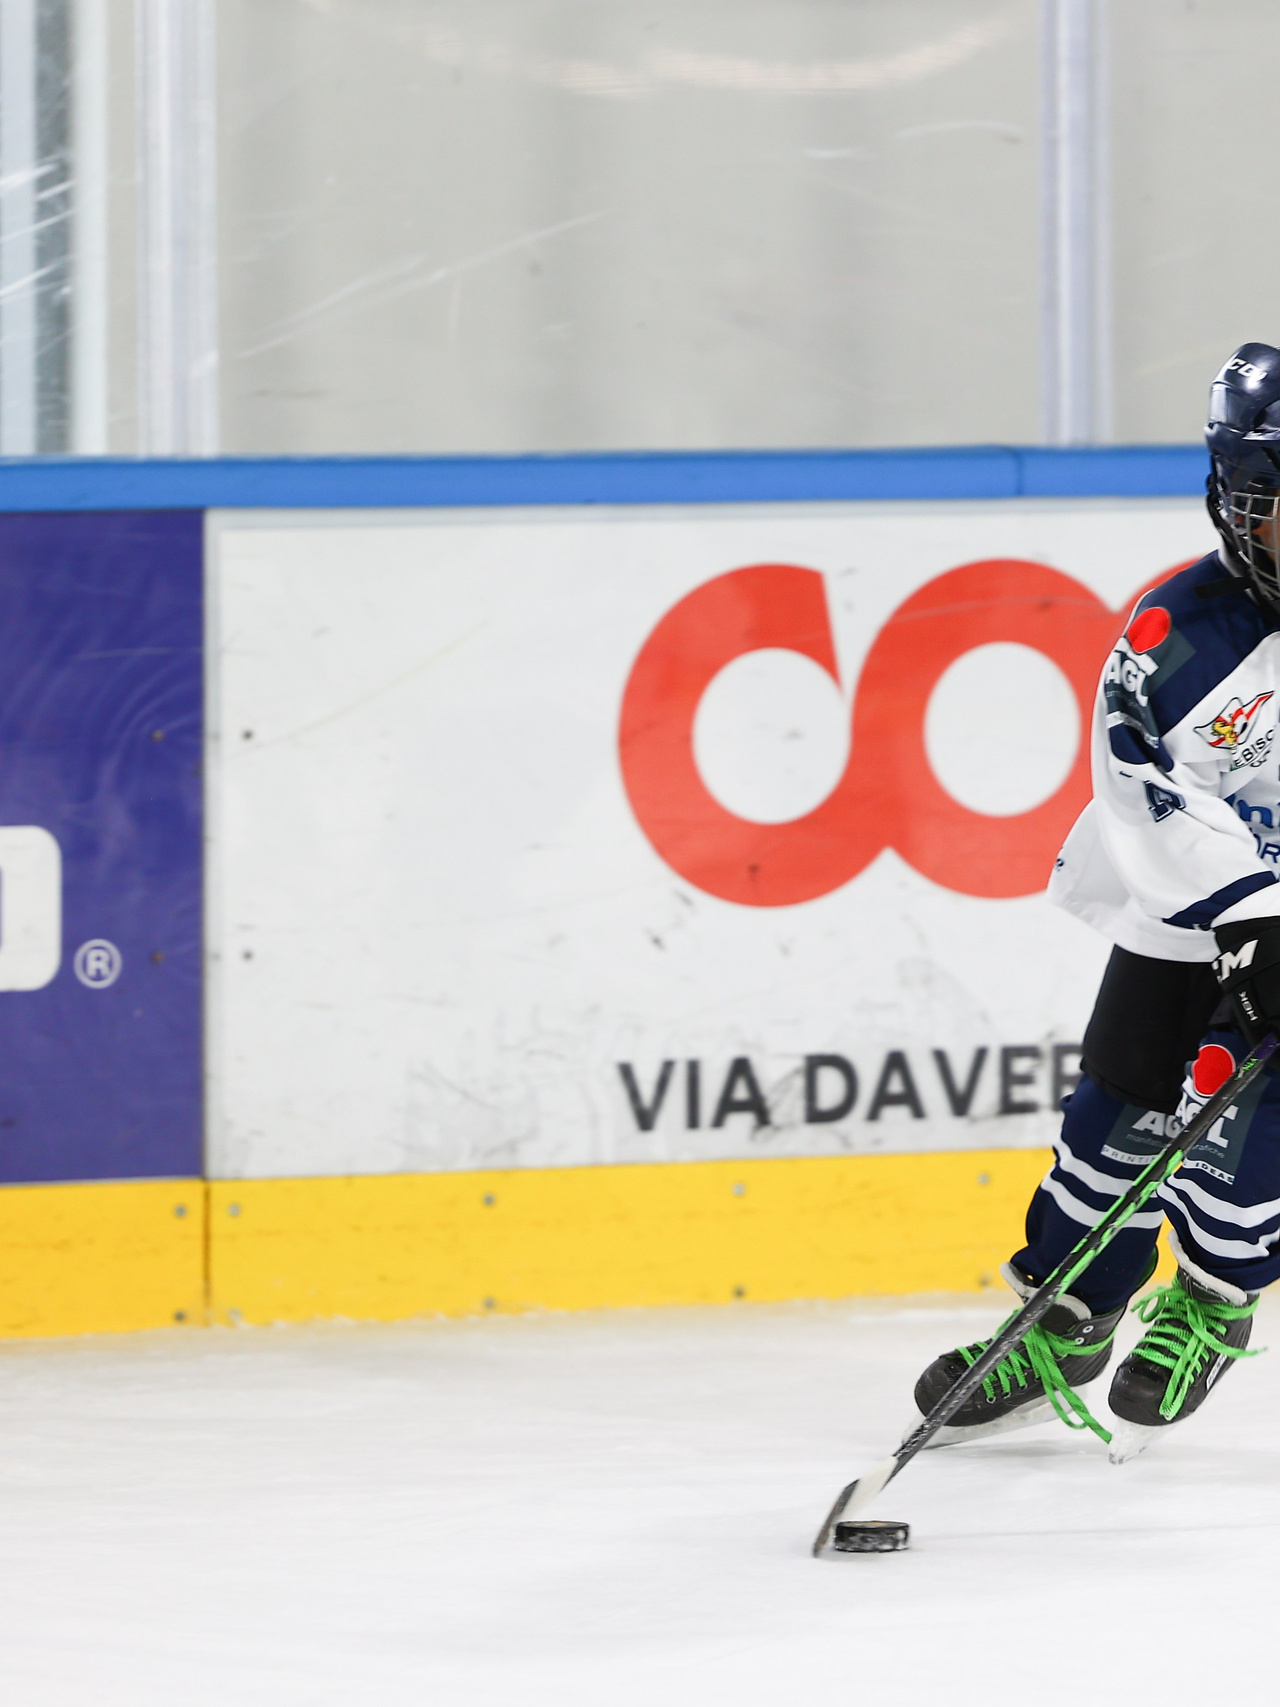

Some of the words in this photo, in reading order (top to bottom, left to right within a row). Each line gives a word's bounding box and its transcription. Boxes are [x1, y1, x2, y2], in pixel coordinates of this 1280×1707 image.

[617, 1057, 774, 1132] VIA
[1131, 1110, 1182, 1139] AG
[1195, 1161, 1235, 1183] IDEAS
